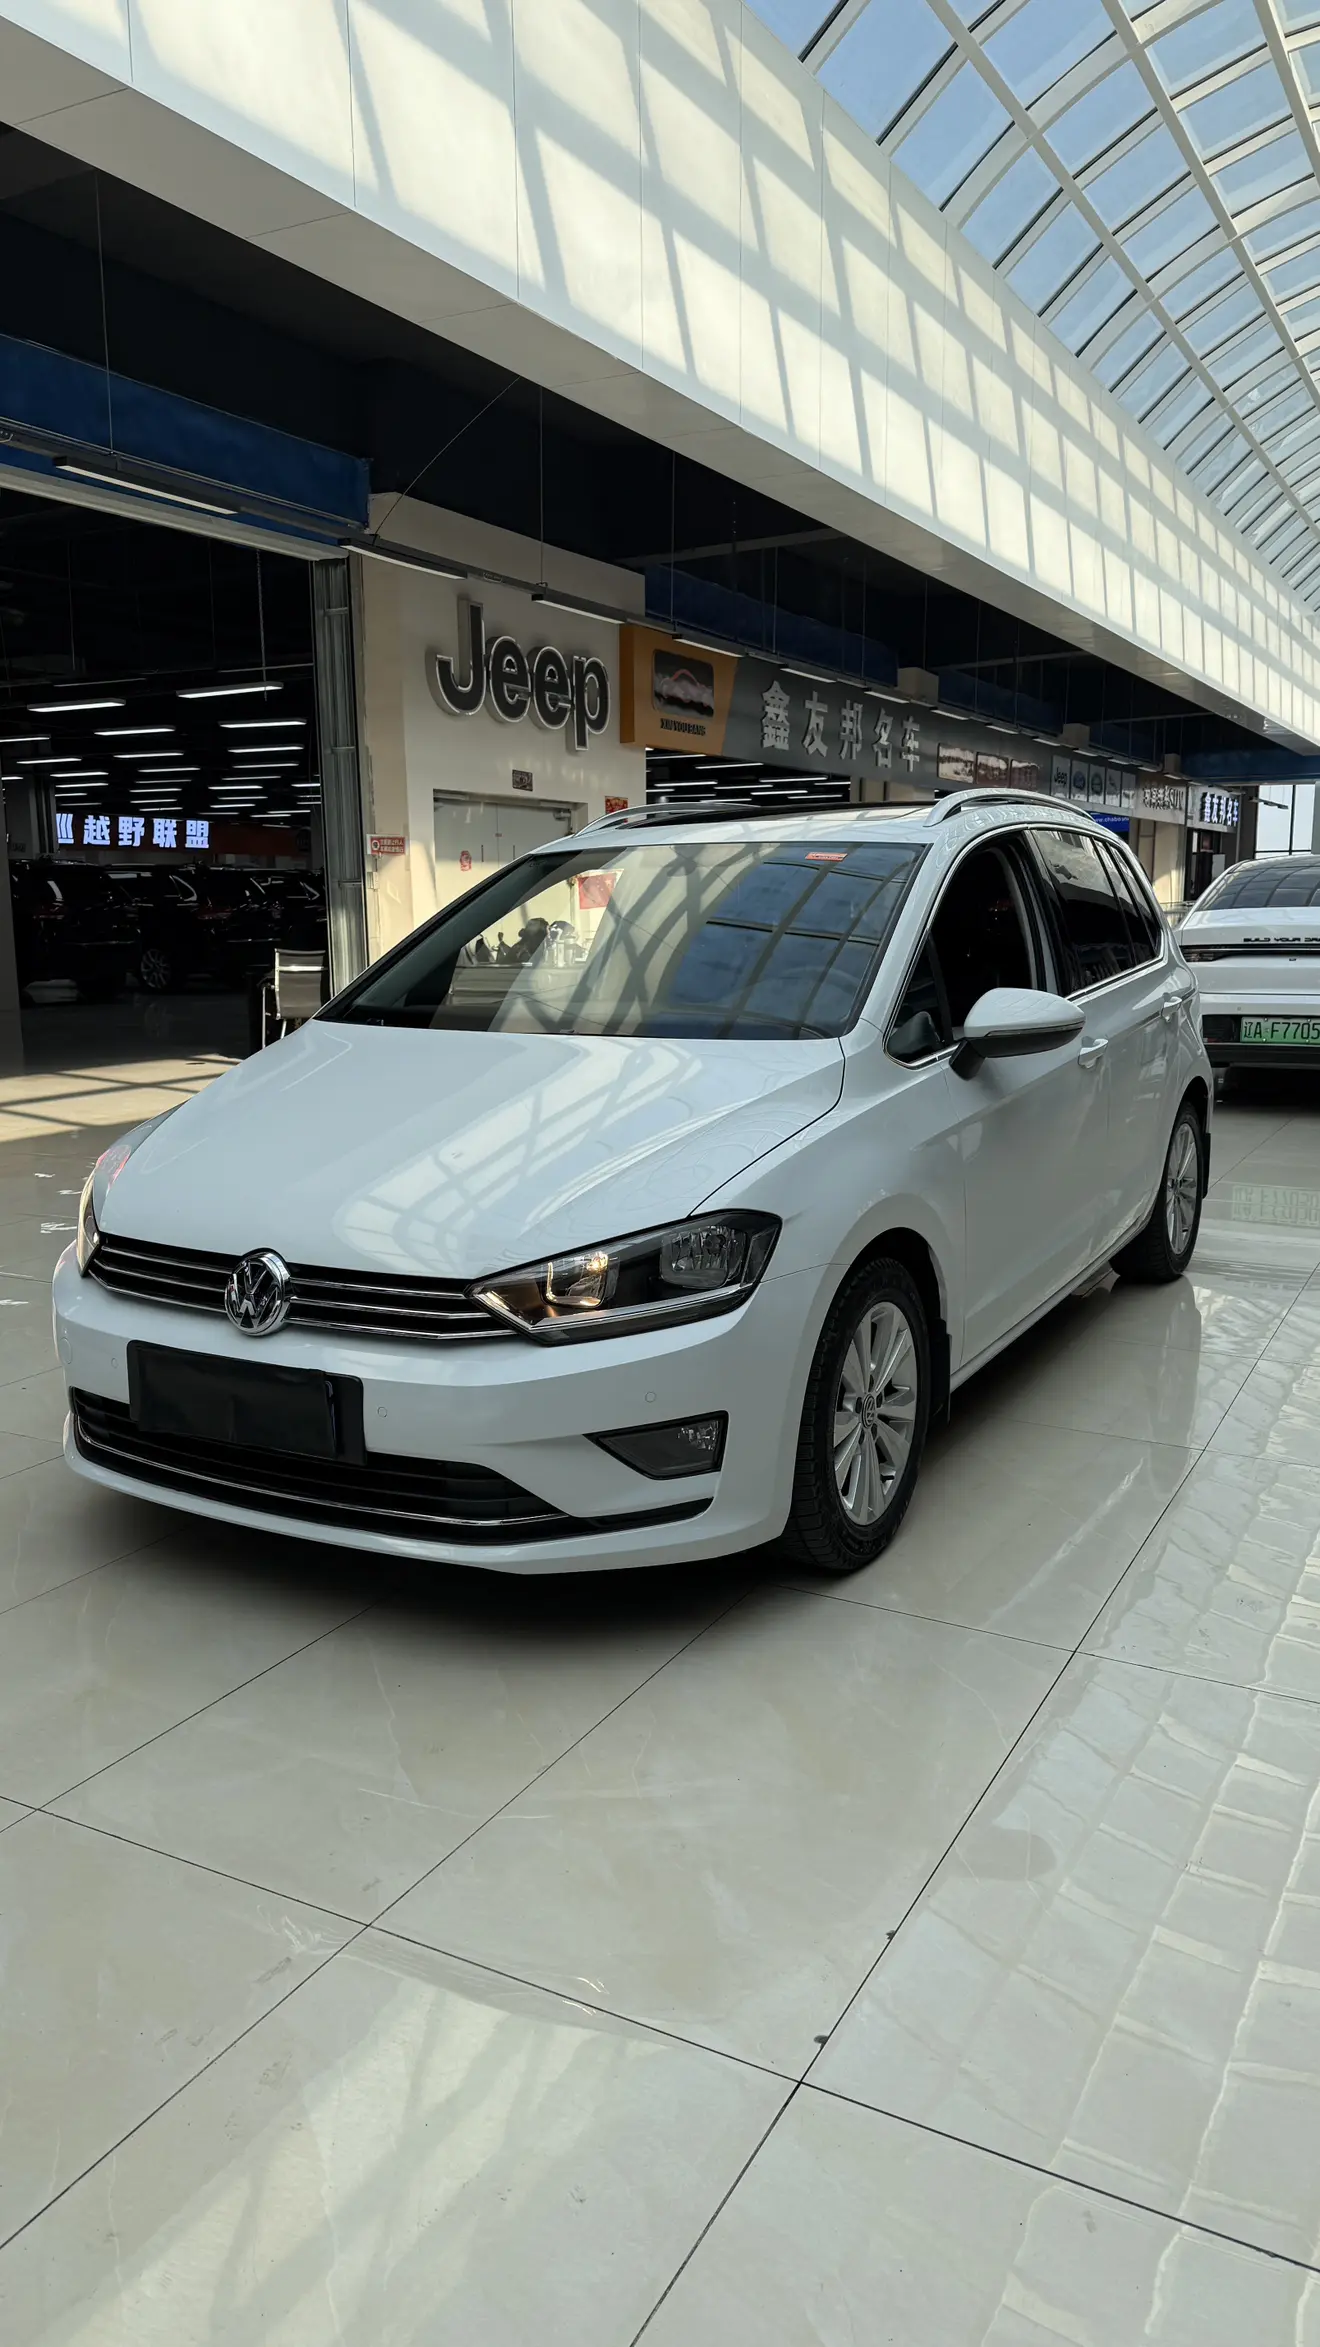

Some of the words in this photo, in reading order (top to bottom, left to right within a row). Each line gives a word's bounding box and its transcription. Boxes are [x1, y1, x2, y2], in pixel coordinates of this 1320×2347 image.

[427, 598, 611, 752] Jeep
[761, 680, 921, 772] 鑫友邦名车
[1054, 766, 1068, 787] Jeep
[1203, 791, 1239, 827] 鑫友邦名车
